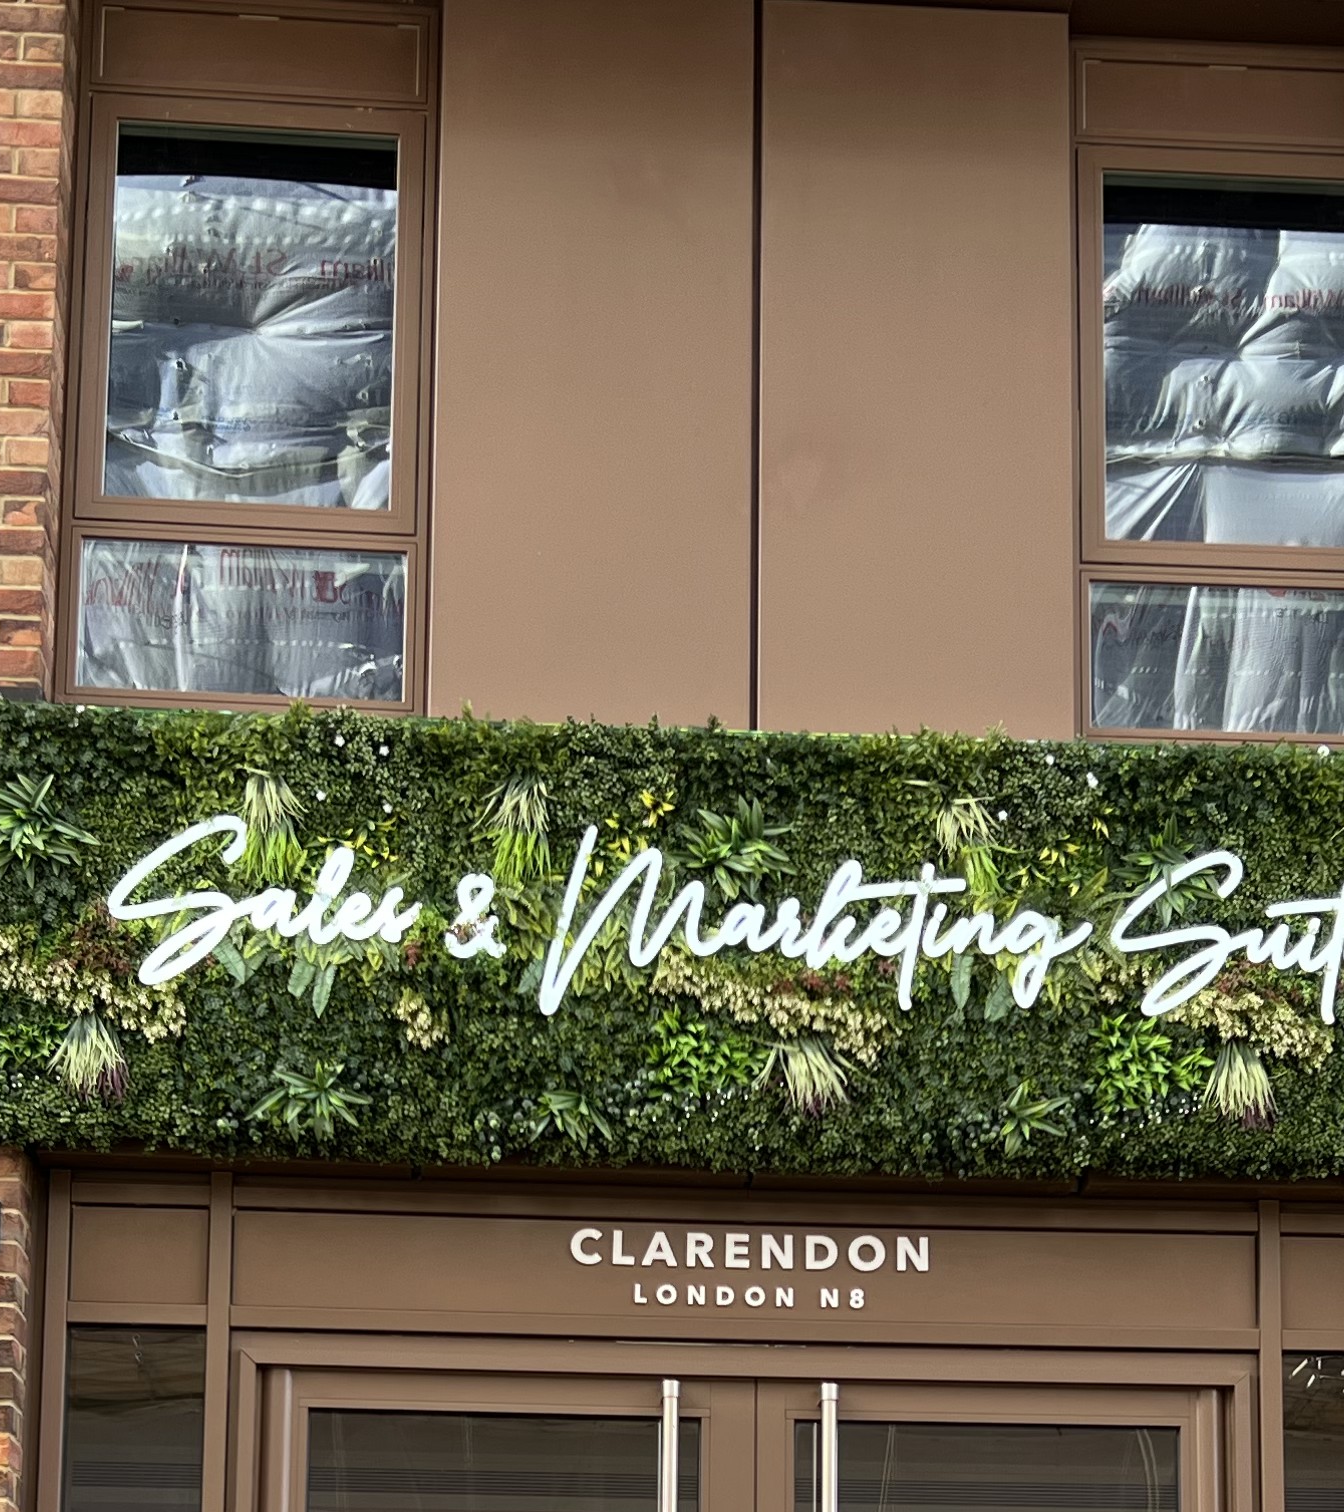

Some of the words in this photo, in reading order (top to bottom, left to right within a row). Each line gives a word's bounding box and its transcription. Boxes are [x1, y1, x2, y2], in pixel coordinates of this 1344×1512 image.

[109, 814, 424, 986] Sales
[444, 873, 507, 959] &
[539, 825, 1093, 1016] Marketing
[570, 1228, 930, 1272] CLARENDON
[634, 1283, 795, 1308] LONDON
[820, 1288, 866, 1309] N8
